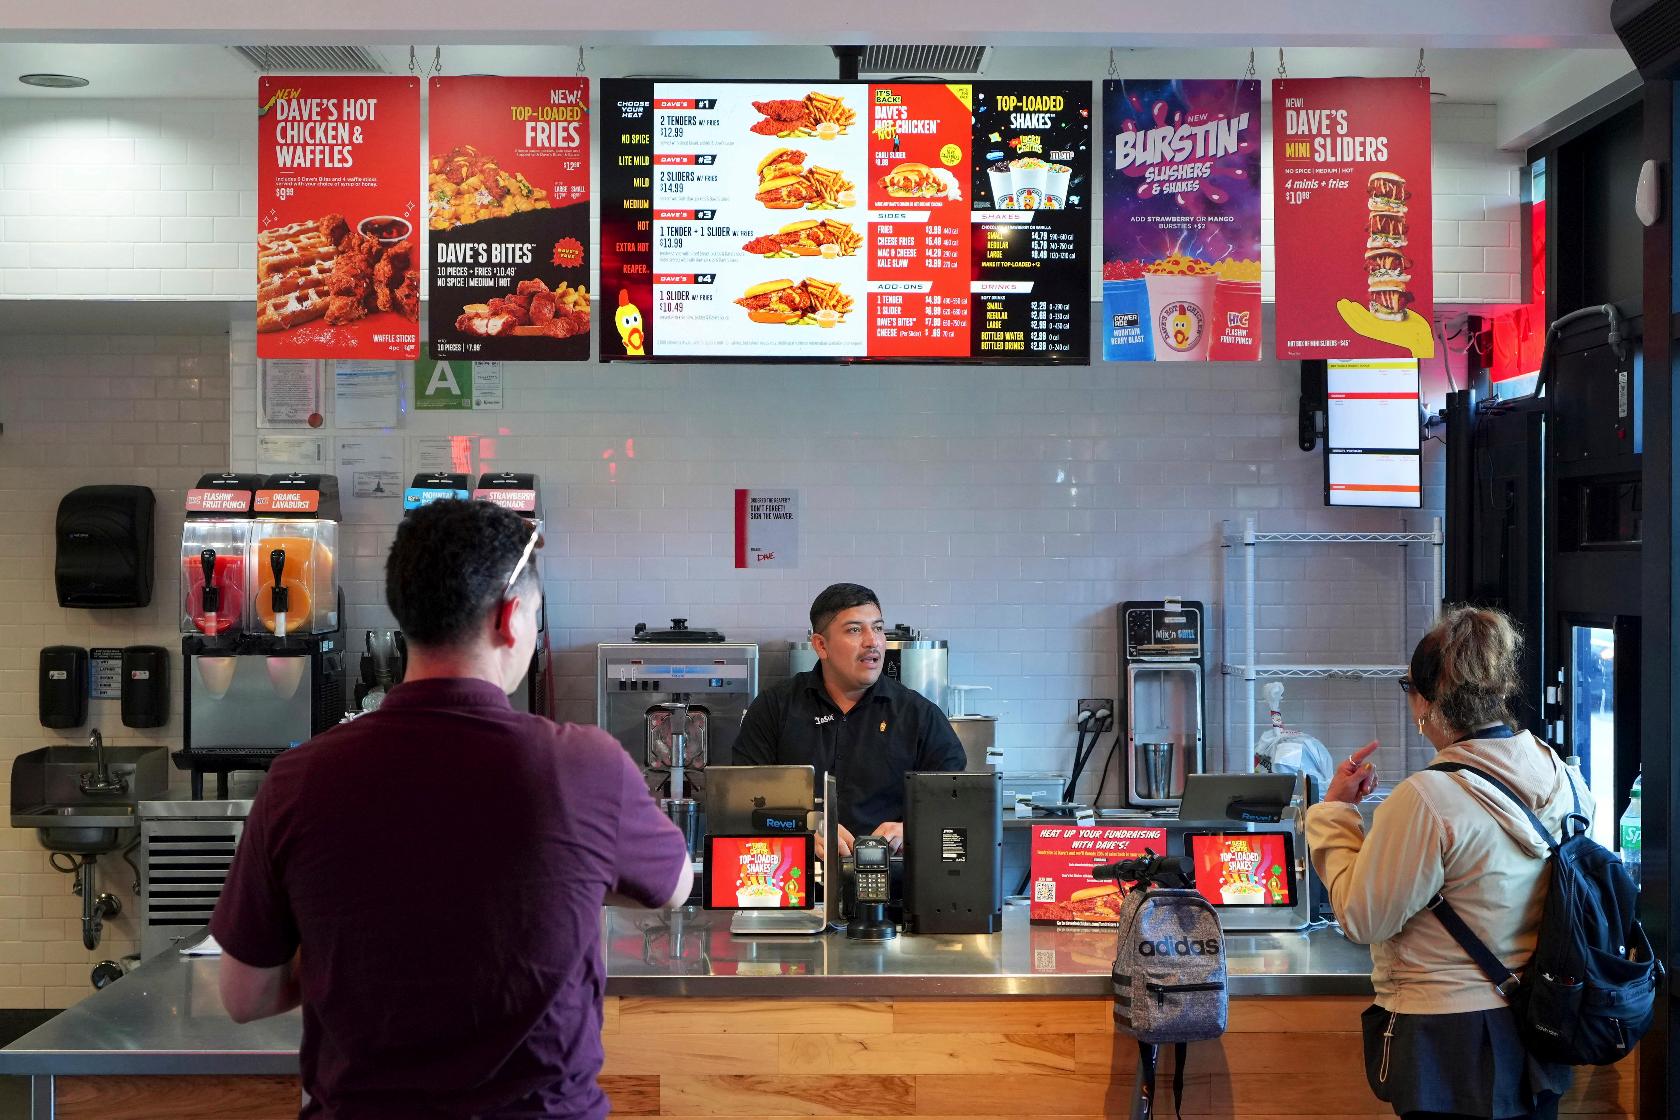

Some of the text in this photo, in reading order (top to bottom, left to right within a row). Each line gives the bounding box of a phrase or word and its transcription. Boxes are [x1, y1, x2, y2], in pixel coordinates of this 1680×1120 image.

[276, 88, 301, 99] NEW
[550, 89, 581, 104] NEW!
[996, 96, 1064, 111] TOP-LOADED
[1286, 98, 1303, 108] NEW!
[276, 98, 377, 120] DAVE'S HOT
[511, 106, 581, 120] TOP-LOADED
[875, 106, 907, 119] DAVE'S
[660, 116, 664, 126] 2
[667, 116, 696, 126] TENDERS
[1010, 113, 1051, 128] SHAKES
[1188, 113, 1208, 123] NEW
[1286, 110, 1348, 135] DAVE'S
[896, 120, 936, 133] CHICKEN
[276, 122, 363, 144] CHICKEN &
[526, 122, 580, 147] FRIES
[660, 128, 683, 137] $12.99
[622, 135, 630, 144] NO
[632, 135, 650, 144] SPICE
[1286, 137, 1388, 162] MINI SLIDERS
[276, 146, 352, 168] WAFFLES
[619, 156, 650, 165] LITE MILD
[660, 172, 664, 181] 2
[667, 172, 694, 181] SLIDERS
[1145, 164, 1211, 182] SLUSHERS
[634, 178, 650, 187] MILD
[660, 183, 683, 192] $14.99
[1152, 180, 1200, 194] & SHAKES
[1285, 179, 1349, 189] 4 minis fries
[624, 200, 649, 208] MEDIUM
[698, 210, 712, 219] #3
[637, 221, 649, 230] HOT
[660, 227, 664, 236] 1
[667, 227, 692, 236] TENDER
[700, 227, 704, 236] 1
[707, 227, 730, 236] SLIDER
[660, 238, 682, 248] $13.99
[878, 237, 914, 245] CHEESE FRIES
[616, 243, 649, 251] EXTRA HOT
[437, 243, 487, 263] DAVE'S
[878, 259, 908, 268] KALE SLAW
[437, 267, 492, 276] 10 PIECES FRIES
[437, 278, 510, 286] NO SPICE MEDIUM HOT
[660, 291, 663, 300] 1
[666, 291, 690, 300] SLIDER
[660, 303, 683, 312] $10.49
[425, 360, 461, 395] A
[489, 492, 535, 500] STRAWBERRY
[1156, 630, 1176, 638] Mix'n
[766, 818, 796, 828] Revel
[1040, 829, 1062, 837] HEAT
[1079, 830, 1102, 838] YOUR
[1104, 830, 1160, 838] FUNDRAISING
[1096, 841, 1130, 849] DAVE'S!
[740, 855, 779, 864] TOP-LOADED
[1220, 852, 1259, 862] TOP-LOADED
[747, 864, 770, 872] SHAKES
[1229, 861, 1253, 870] SHAKES
[1139, 936, 1219, 956] adidas
